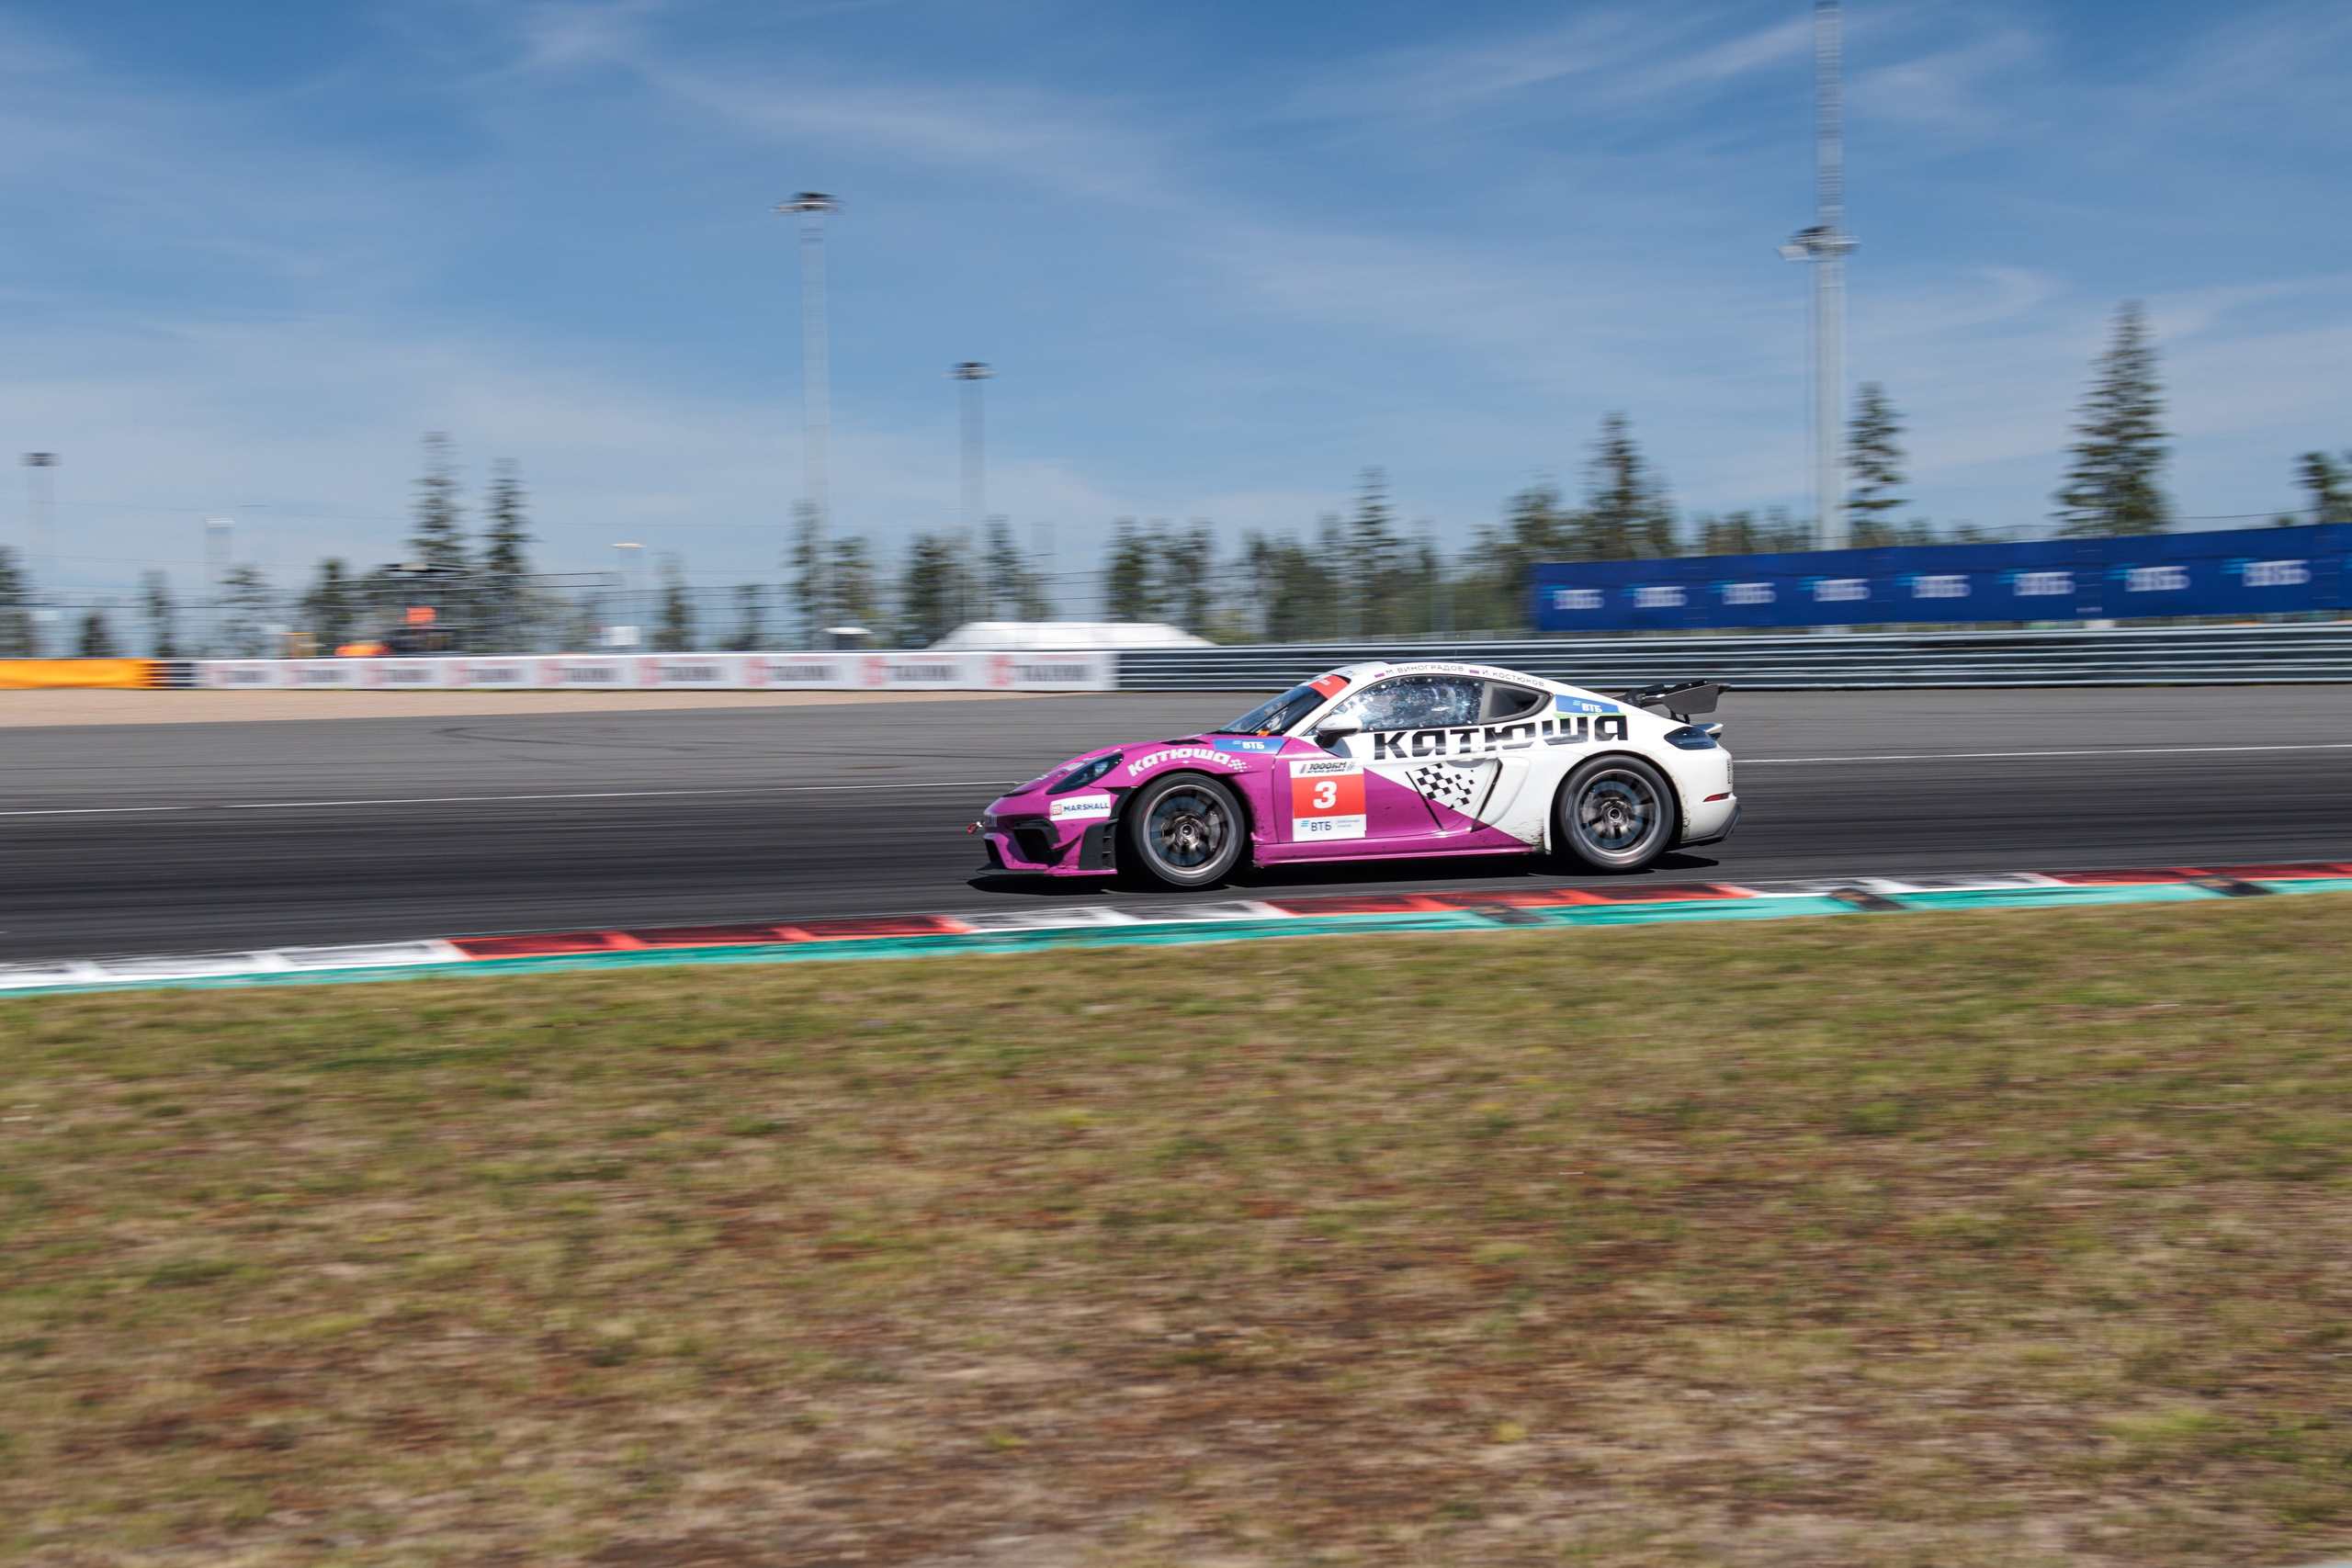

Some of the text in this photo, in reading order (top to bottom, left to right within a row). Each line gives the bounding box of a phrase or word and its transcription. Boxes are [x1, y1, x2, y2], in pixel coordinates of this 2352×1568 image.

[1398, 664, 1464, 673] ВИНОГРАДОВ
[1493, 671, 1544, 687] КОСТЮКОВ
[1581, 703, 1603, 713] ВТБ
[1242, 741, 1265, 750] ВТБ
[1313, 781, 1338, 809] 3
[1063, 803, 1110, 812] MARSHALL
[1311, 821, 1332, 831] ВТБ
